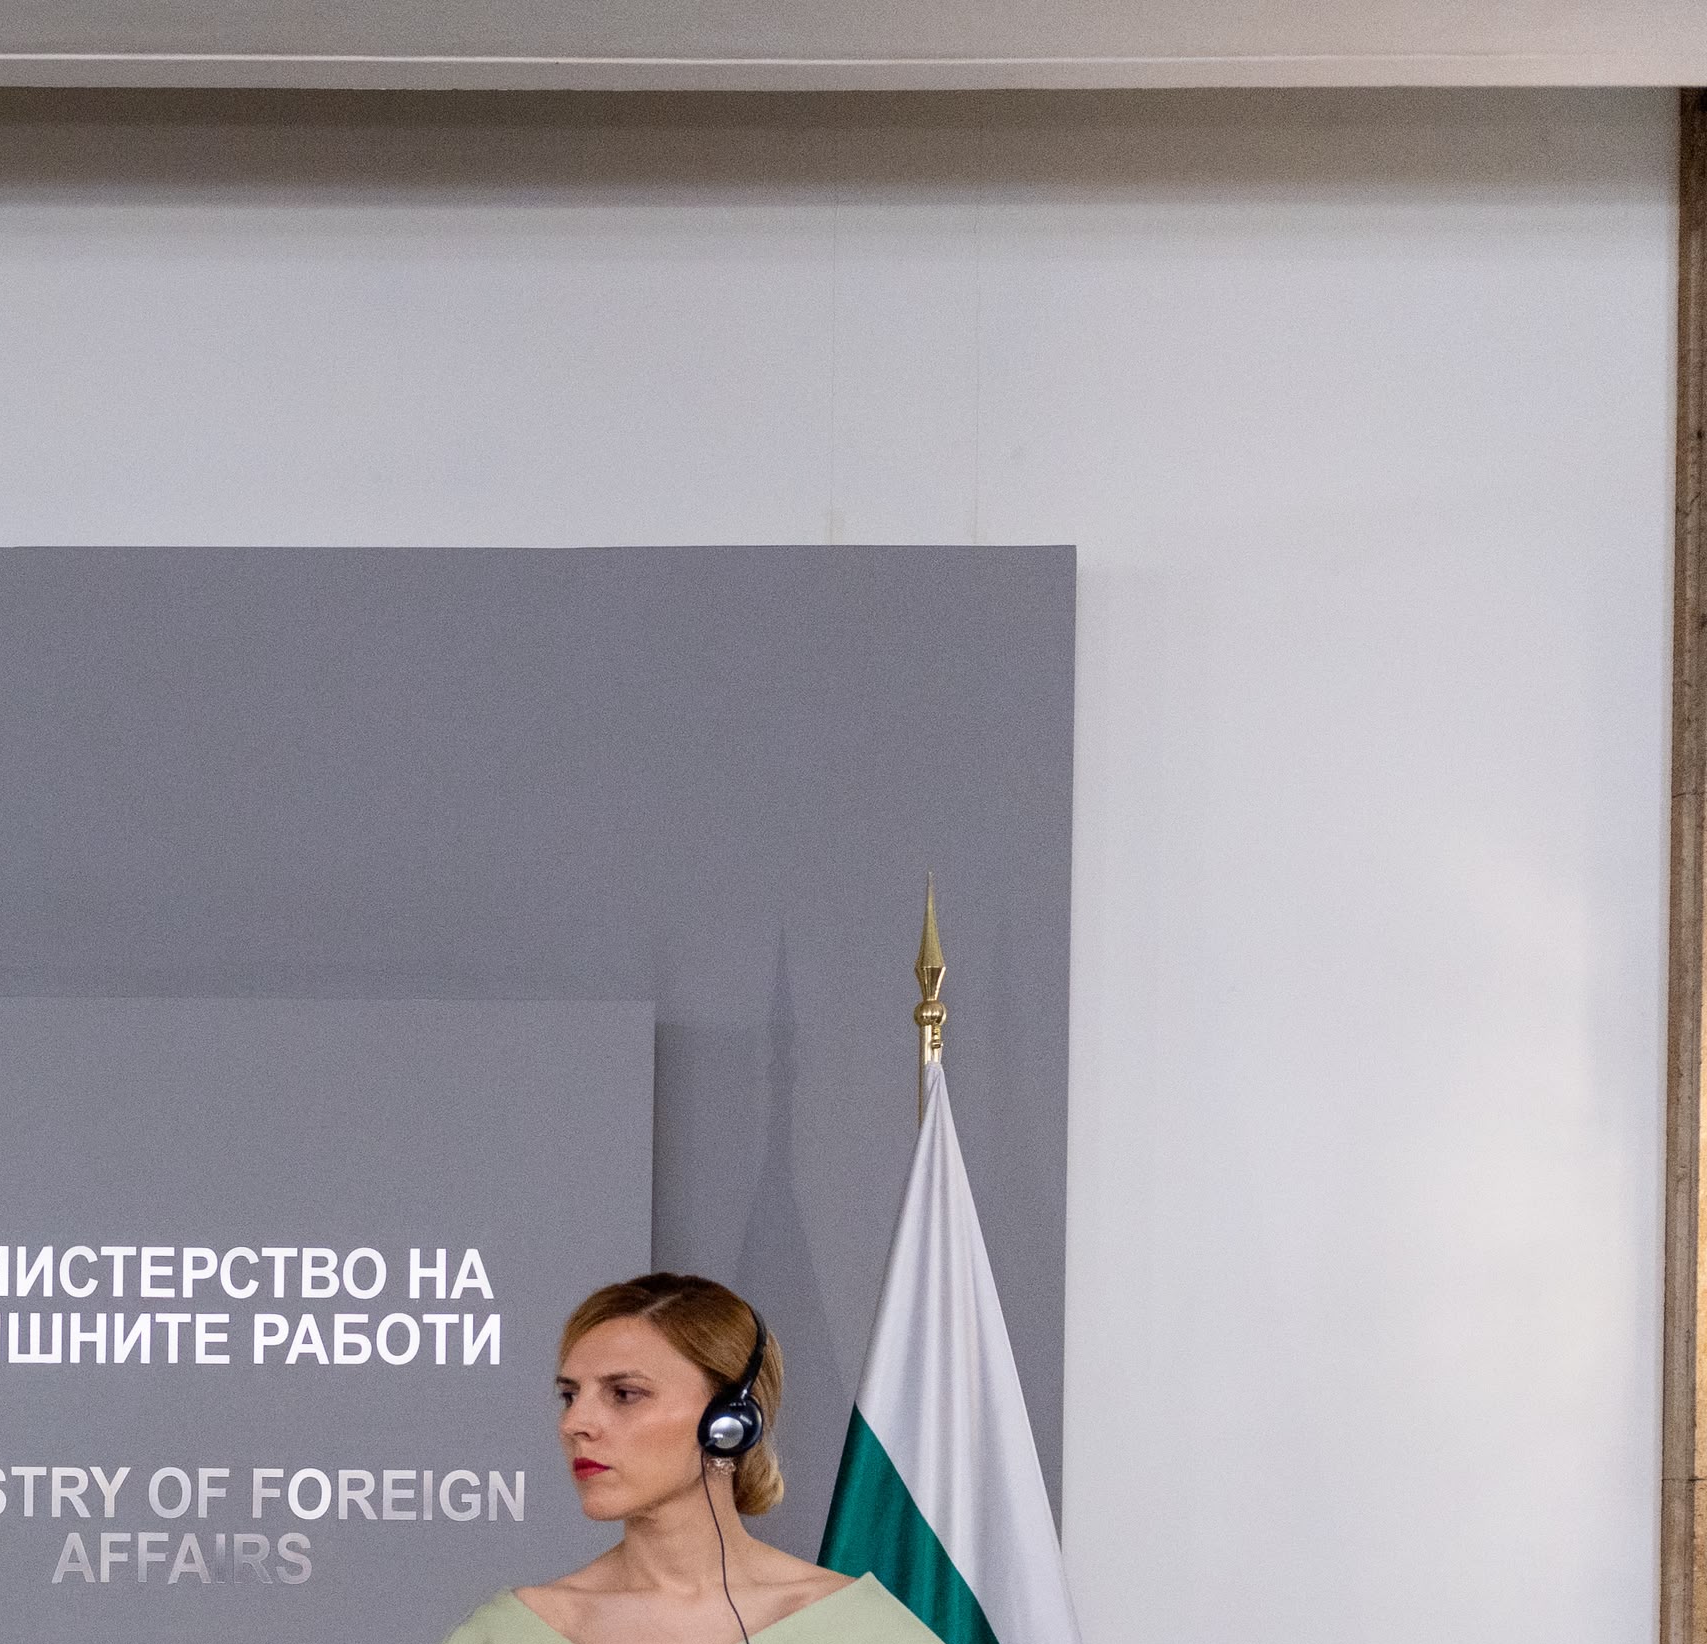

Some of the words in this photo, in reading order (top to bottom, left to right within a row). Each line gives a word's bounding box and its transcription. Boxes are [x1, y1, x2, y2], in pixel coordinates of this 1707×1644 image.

[407, 1247, 495, 1300] НА
[252, 1312, 502, 1366] РАБОТИ
[147, 1465, 230, 1519] OF
[251, 1467, 526, 1522] FOREIGN
[51, 1531, 313, 1585] AFFAIRS
